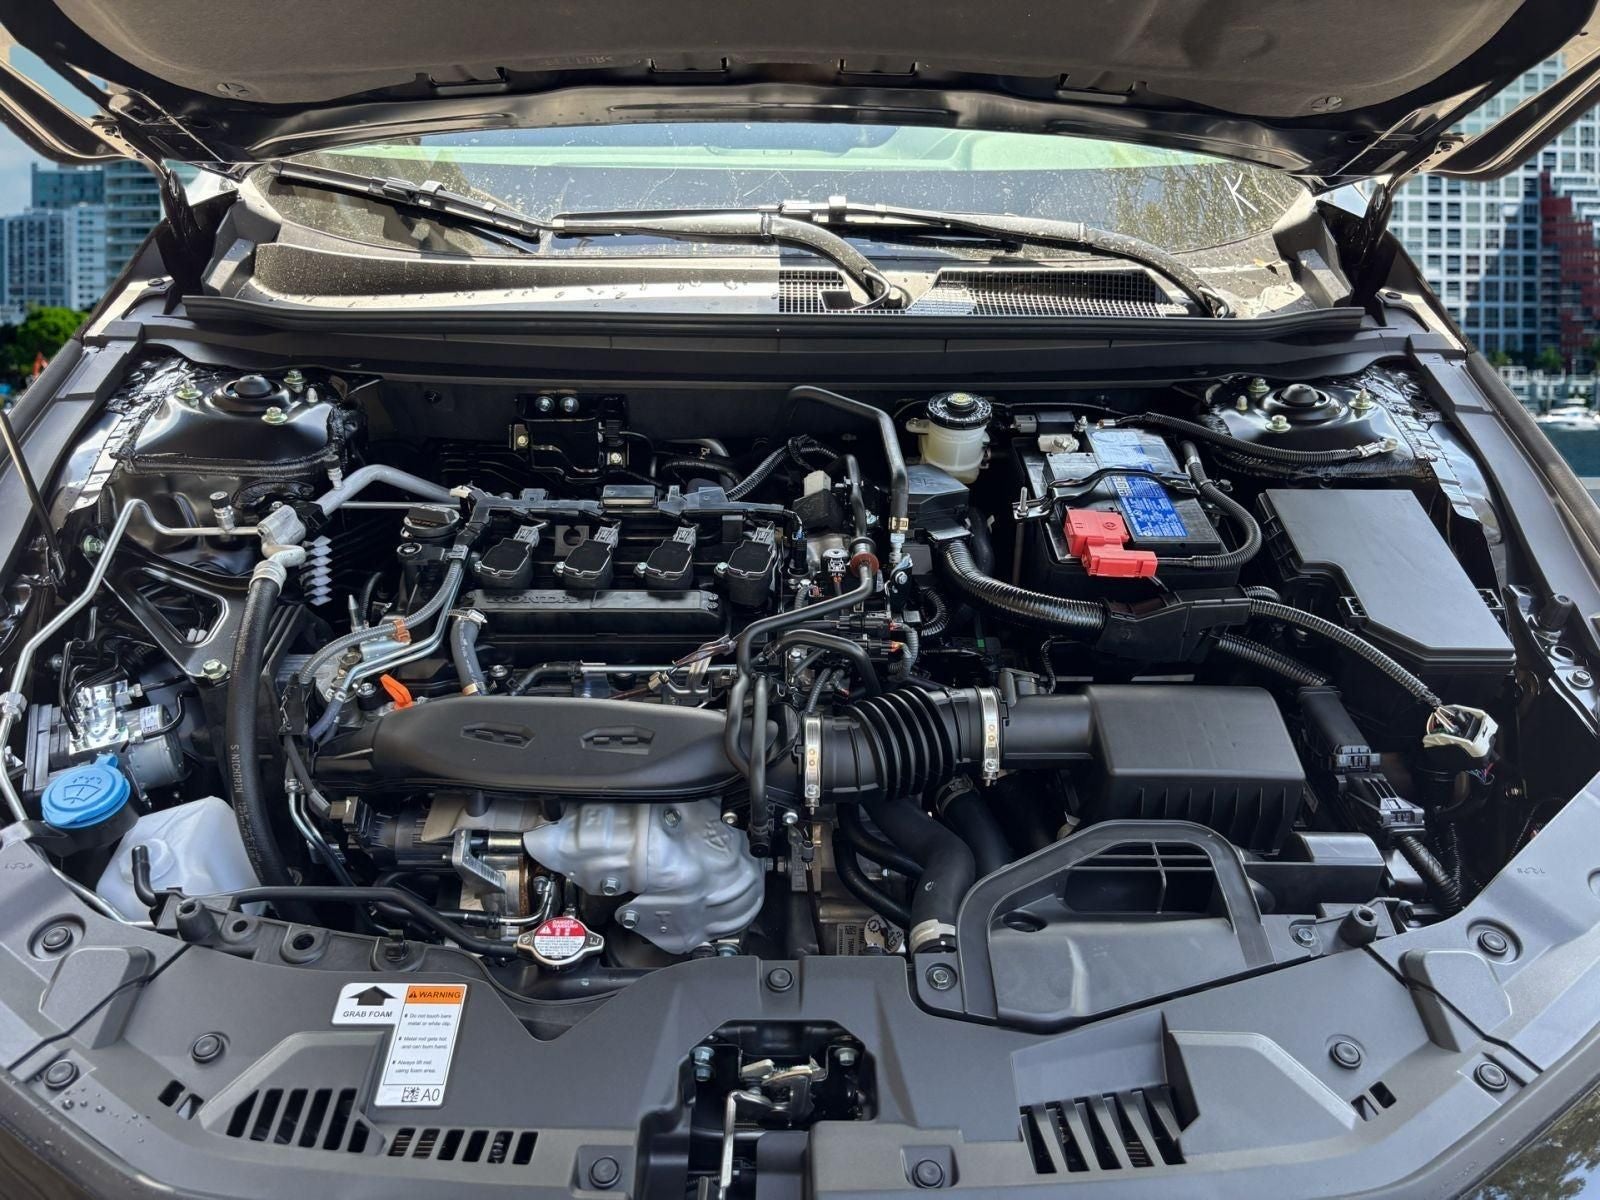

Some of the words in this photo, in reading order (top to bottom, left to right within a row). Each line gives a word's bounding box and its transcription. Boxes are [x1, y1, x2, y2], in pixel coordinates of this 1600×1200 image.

[419, 991, 461, 999] WARNING
[342, 1010, 367, 1018] GRAB
[368, 1010, 393, 1018] FOAM
[420, 1087, 441, 1102] A0
